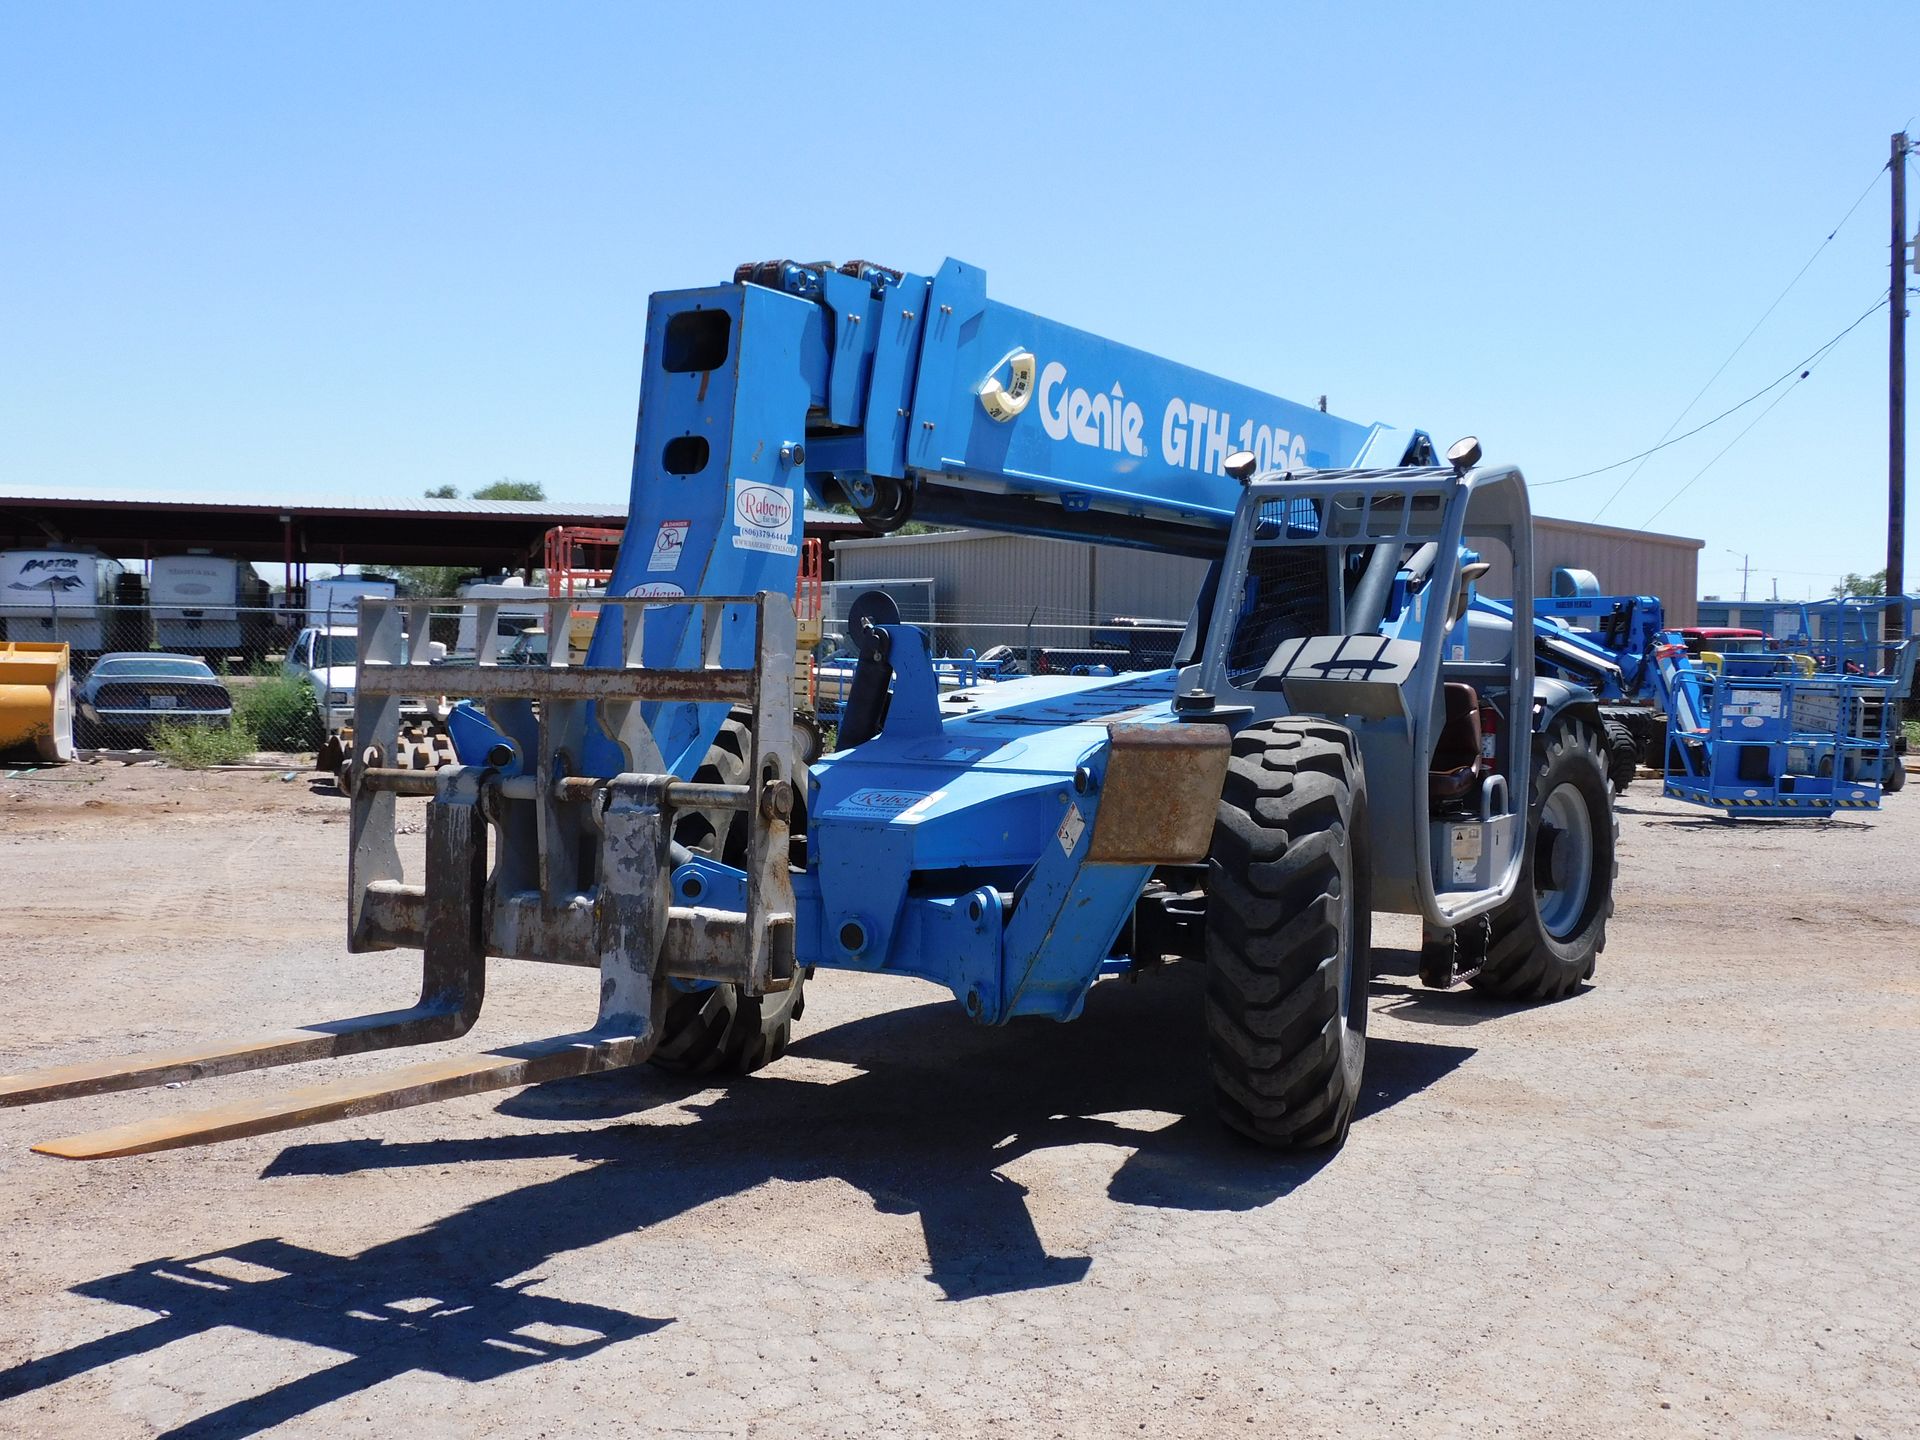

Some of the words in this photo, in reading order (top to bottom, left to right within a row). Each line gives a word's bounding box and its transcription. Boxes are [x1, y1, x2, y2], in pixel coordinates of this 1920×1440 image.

[1039, 361, 1143, 456] Genie
[1162, 397, 1306, 477] GTH-1056
[741, 493, 787, 523] Rabern
[20, 559, 78, 574] RAPTOR
[800, 622, 805, 631] 3
